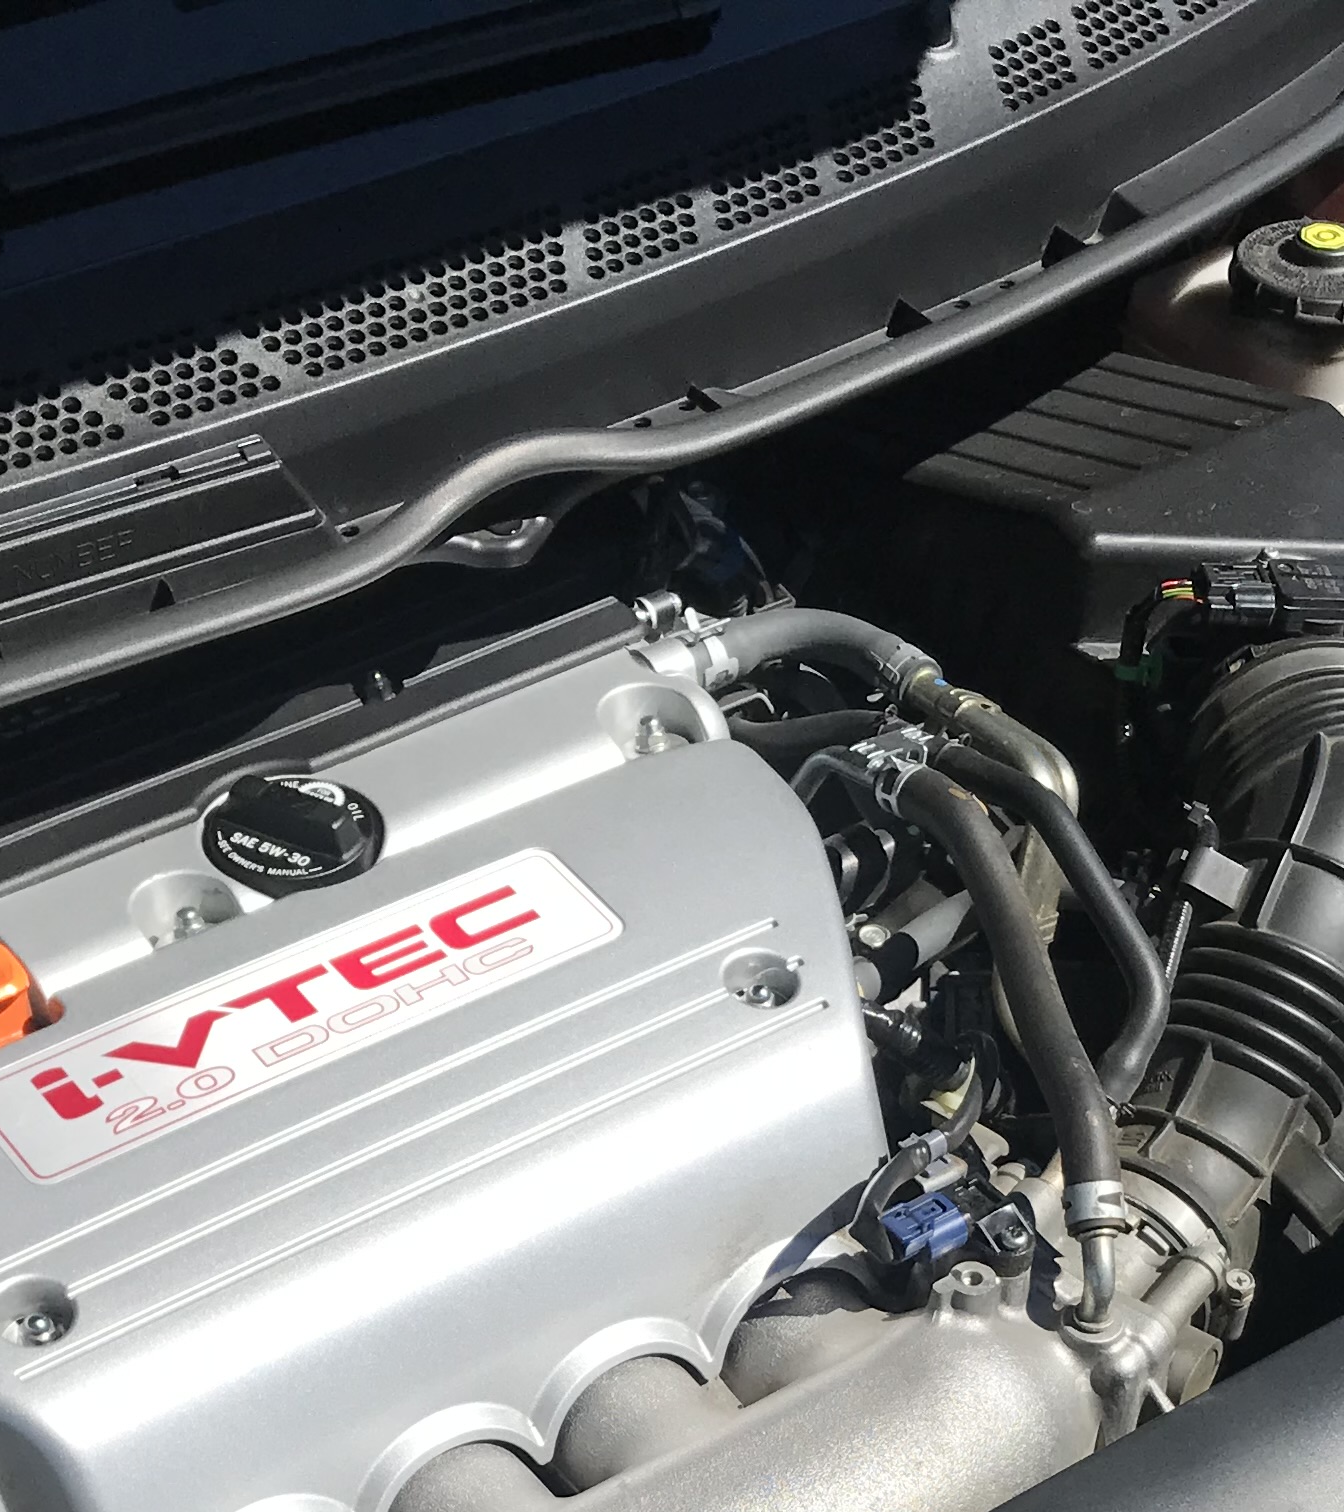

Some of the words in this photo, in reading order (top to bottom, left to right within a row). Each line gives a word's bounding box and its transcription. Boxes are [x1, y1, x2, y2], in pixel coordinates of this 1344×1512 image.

[347, 803, 364, 821] OIL
[227, 852, 265, 873] OWNER'S
[267, 867, 309, 877] MANUAL
[229, 831, 260, 850] SAE
[258, 841, 311, 867] 5W-30
[31, 885, 541, 1121] i-VTEC
[105, 1065, 236, 1134] 2.0
[252, 936, 535, 1067] DOHC
